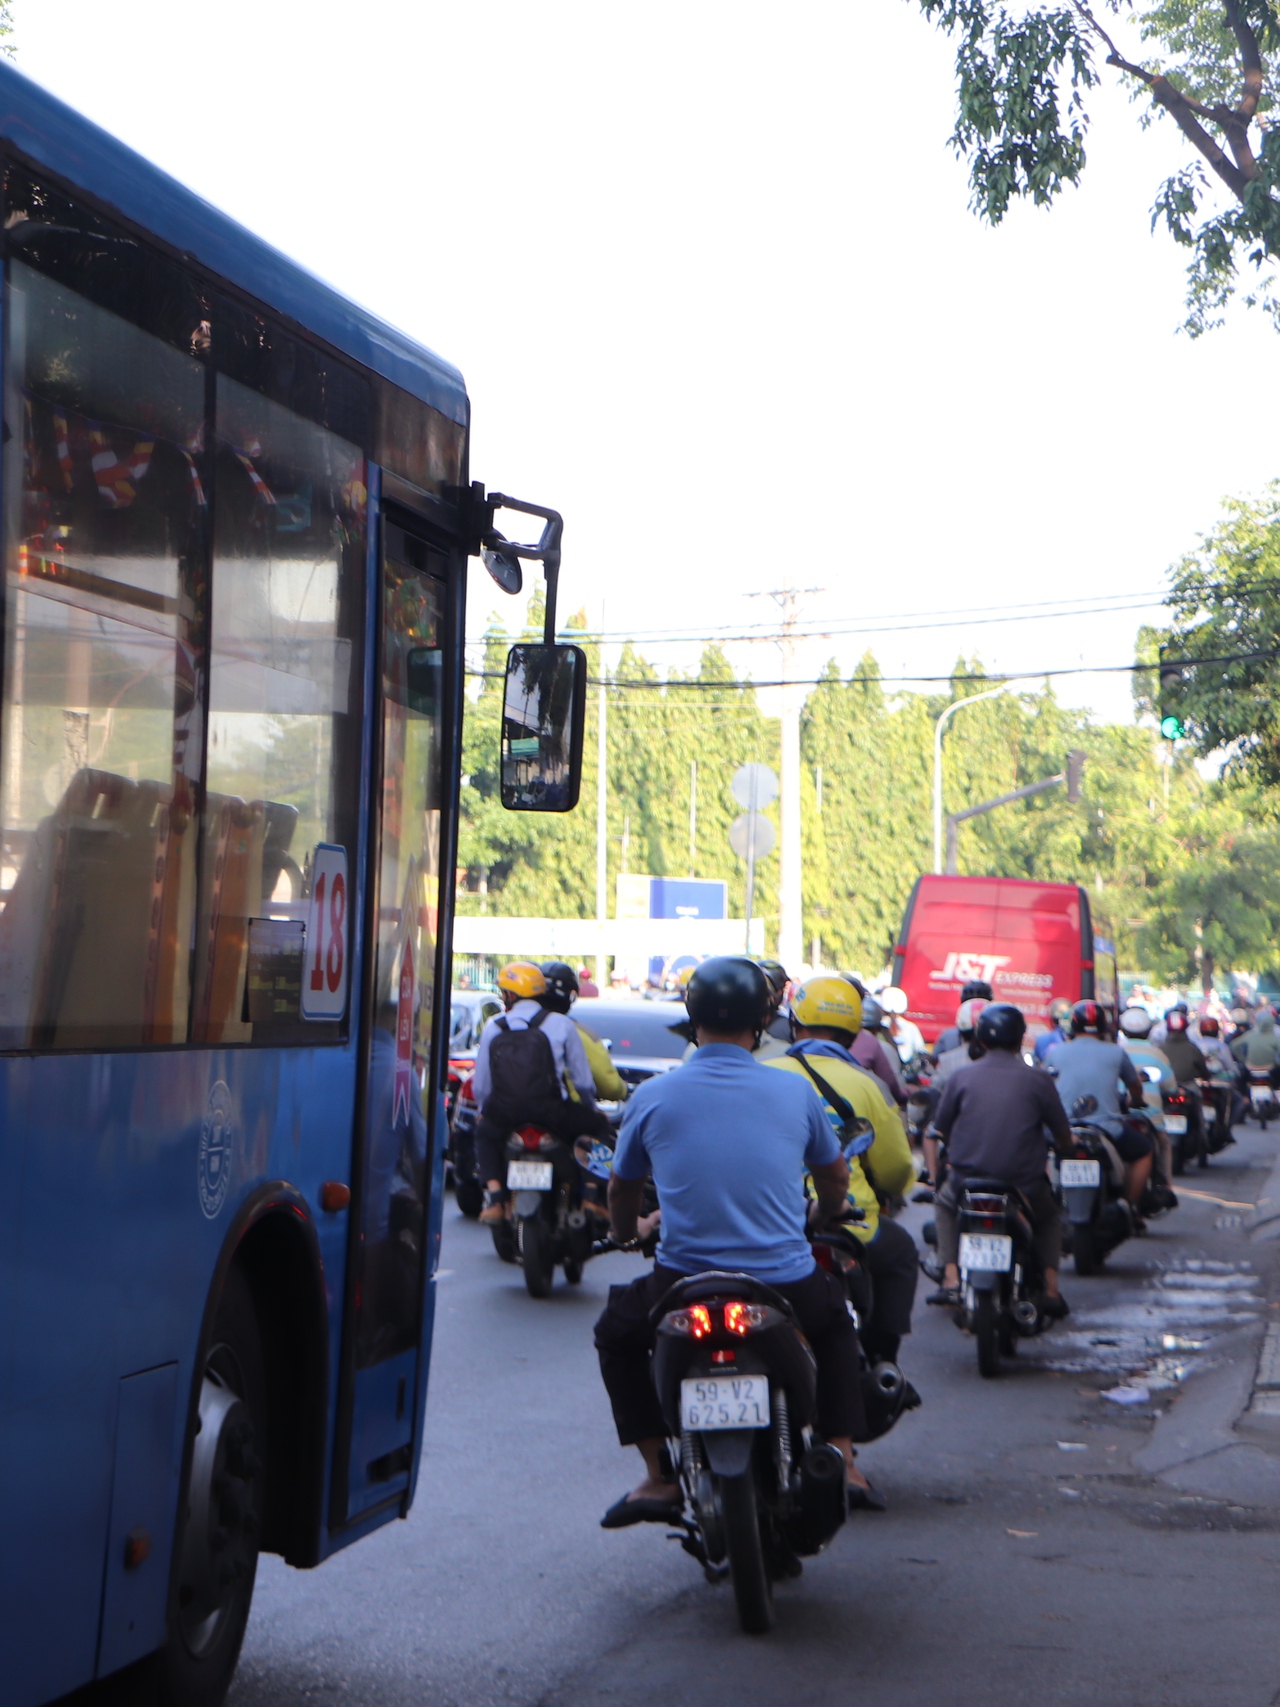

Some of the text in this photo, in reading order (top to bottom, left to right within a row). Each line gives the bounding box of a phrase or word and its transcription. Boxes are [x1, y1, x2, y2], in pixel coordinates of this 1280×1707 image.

[310, 872, 346, 993] 18
[929, 952, 1054, 989] J&T EXPRESS
[695, 1379, 755, 1402] 59-V2
[689, 1402, 767, 1425] 625.21
